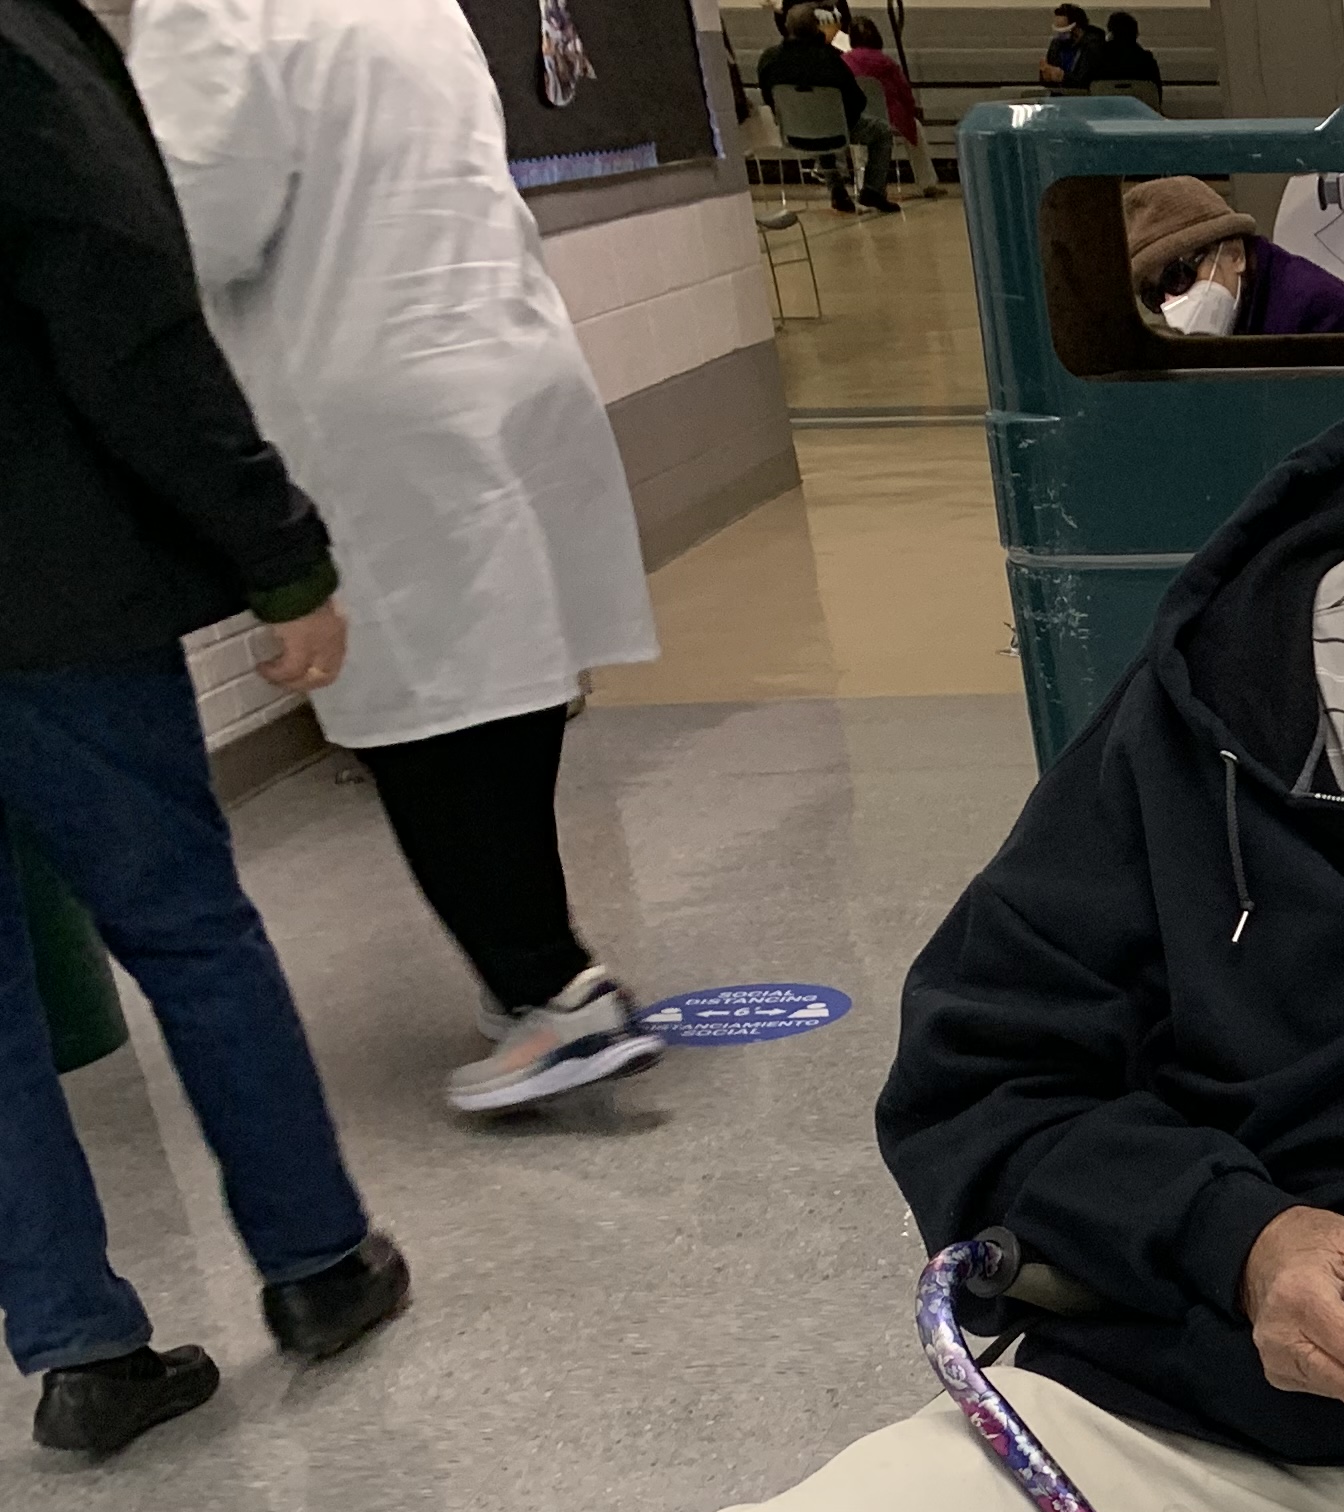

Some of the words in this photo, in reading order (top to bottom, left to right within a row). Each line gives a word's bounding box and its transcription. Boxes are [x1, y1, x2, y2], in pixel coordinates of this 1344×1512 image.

[718, 989, 795, 999] SOCIAL
[686, 995, 818, 1006] DISTANCING
[681, 1028, 762, 1037] SOCIAL
